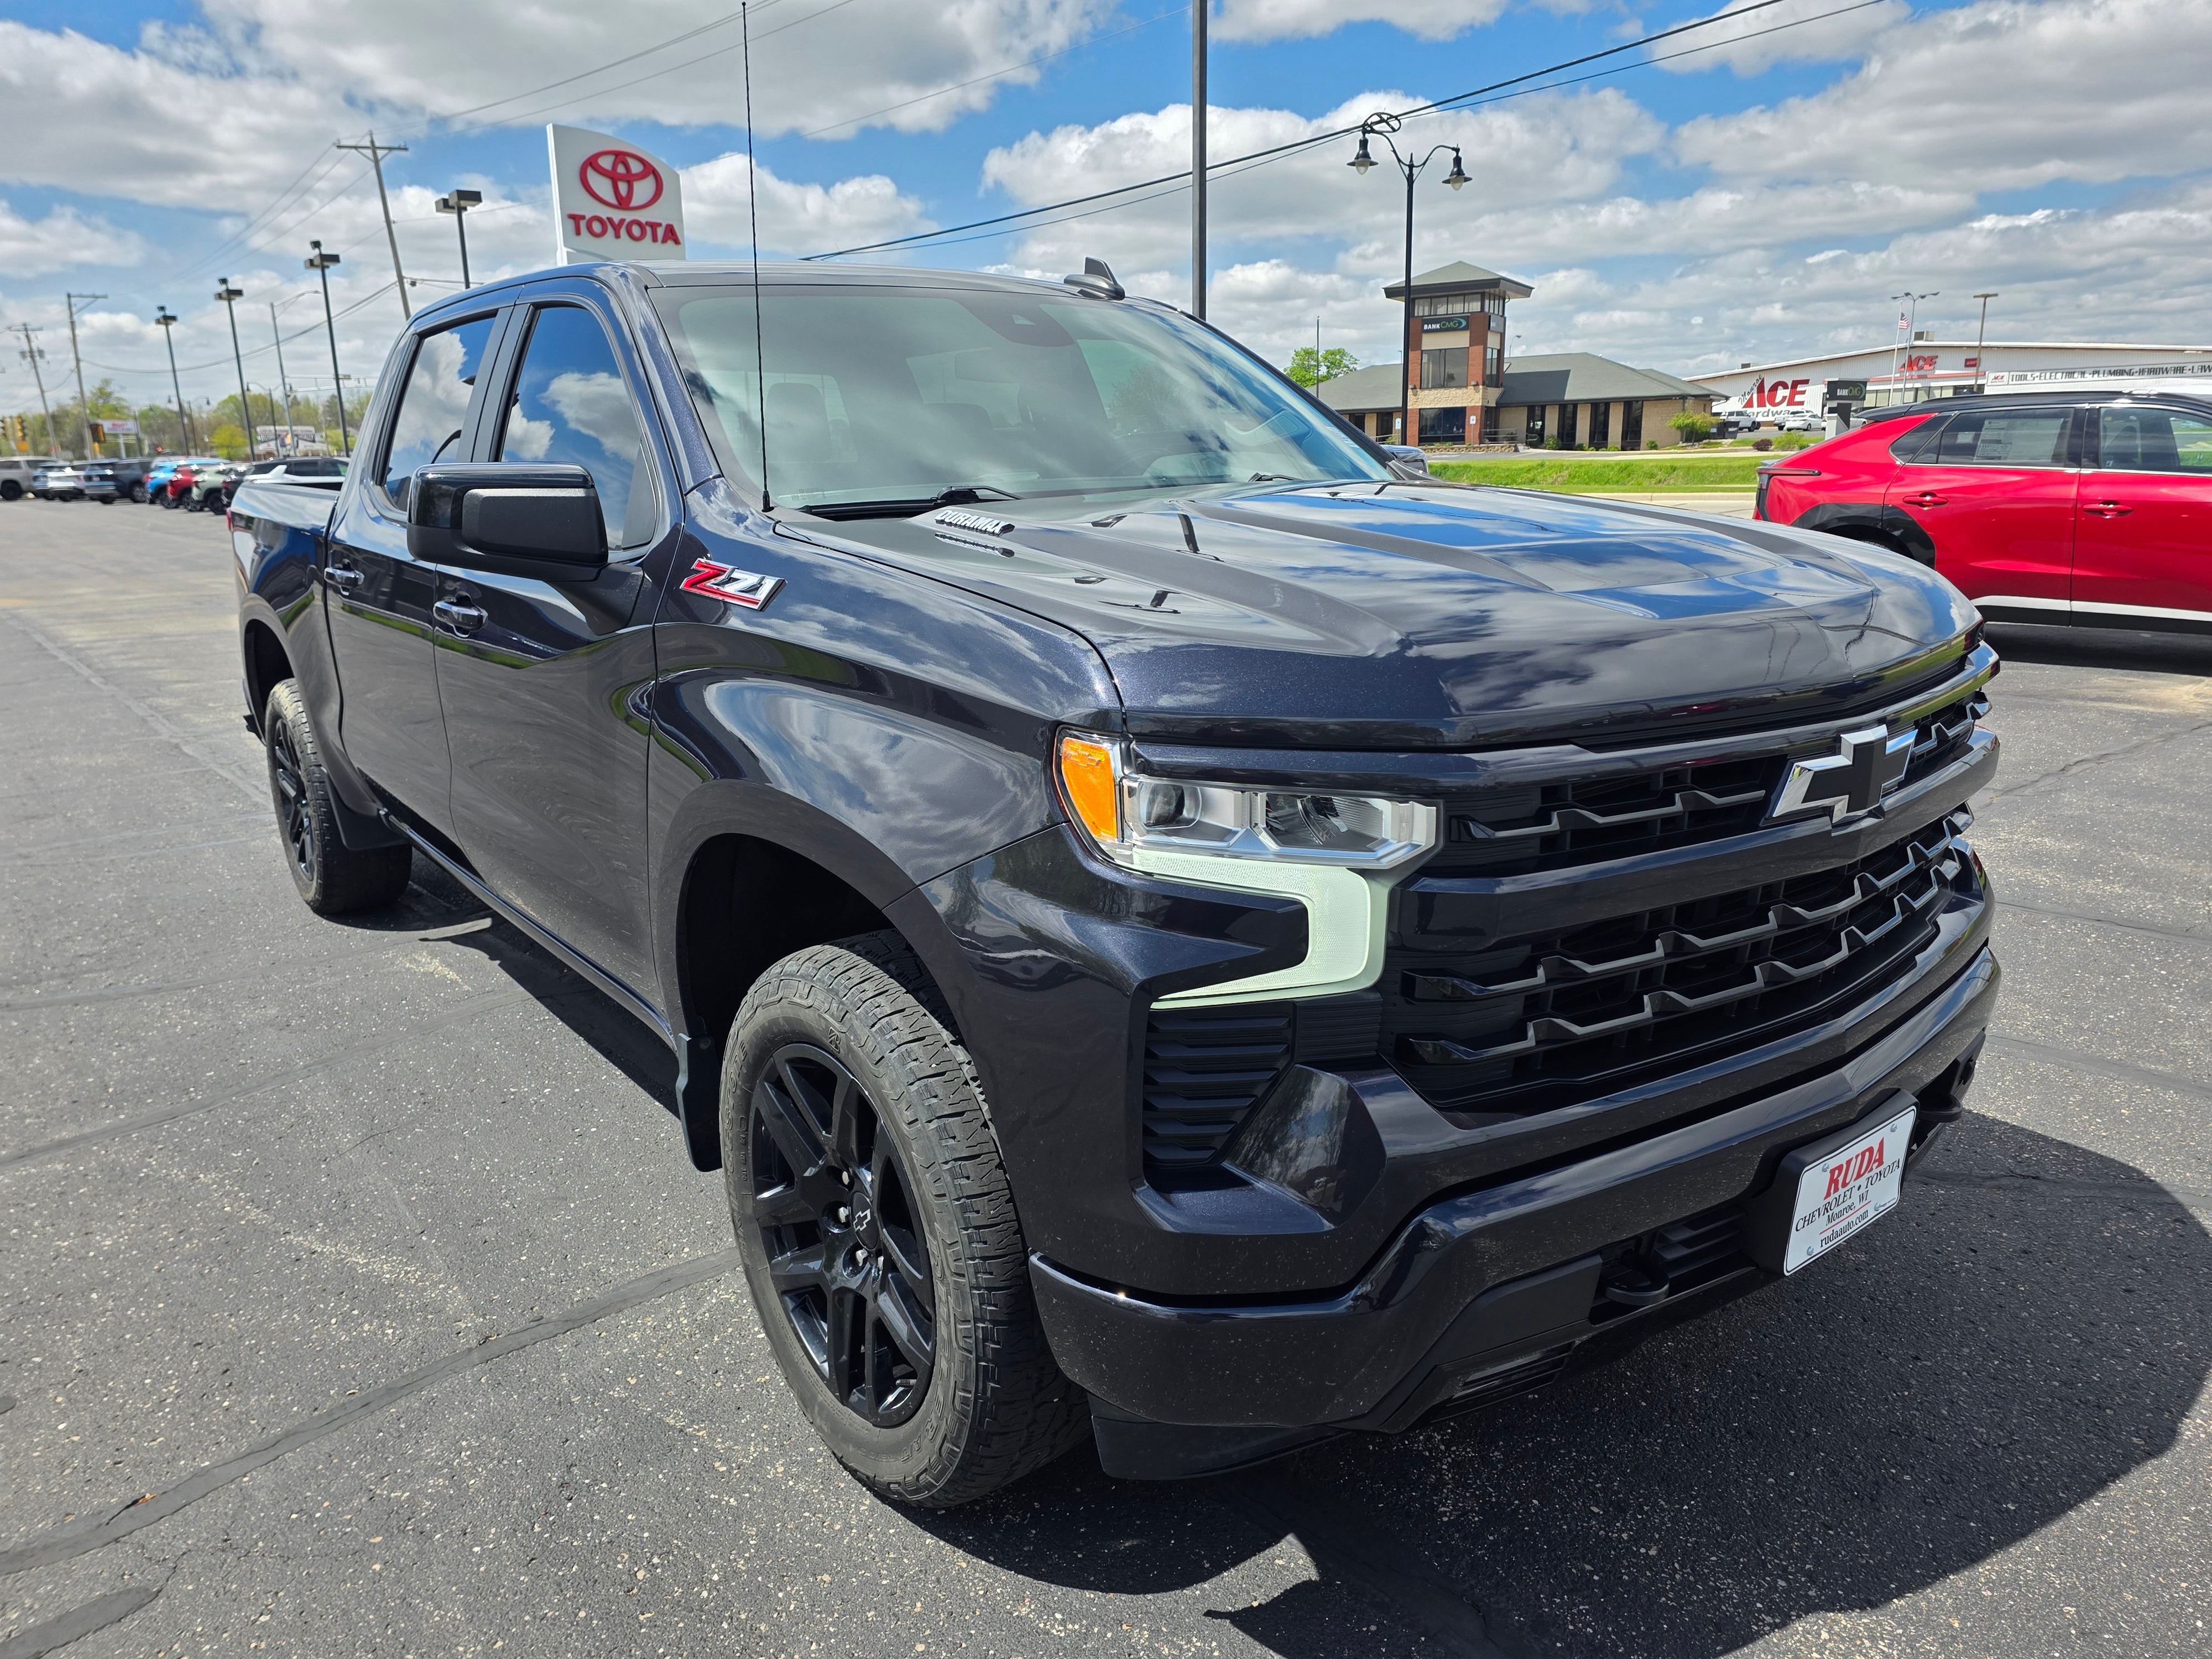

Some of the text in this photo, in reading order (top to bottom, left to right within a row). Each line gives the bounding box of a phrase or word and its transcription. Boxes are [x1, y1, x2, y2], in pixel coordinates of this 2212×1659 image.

[567, 213, 681, 245] TOYOTA
[1897, 354, 1939, 372] ACE
[2011, 373, 2036, 382] TOOLS
[2038, 371, 2088, 380] ELECTRICAL
[2091, 368, 2135, 378] PLUMBING
[2138, 366, 2188, 376] HARDWARE
[1741, 377, 1810, 409] ACE
[935, 509, 1015, 538] DURAMAX
[679, 557, 788, 612] Z71
[1823, 1137, 1884, 1201] RUDA
[1796, 1158, 1900, 1232] CHEVROLET TOYOTA
[1825, 1202, 1856, 1227] Monroe,
[1859, 1189, 1870, 1205] WI
[1820, 1209, 1869, 1249] rudaauto.com
